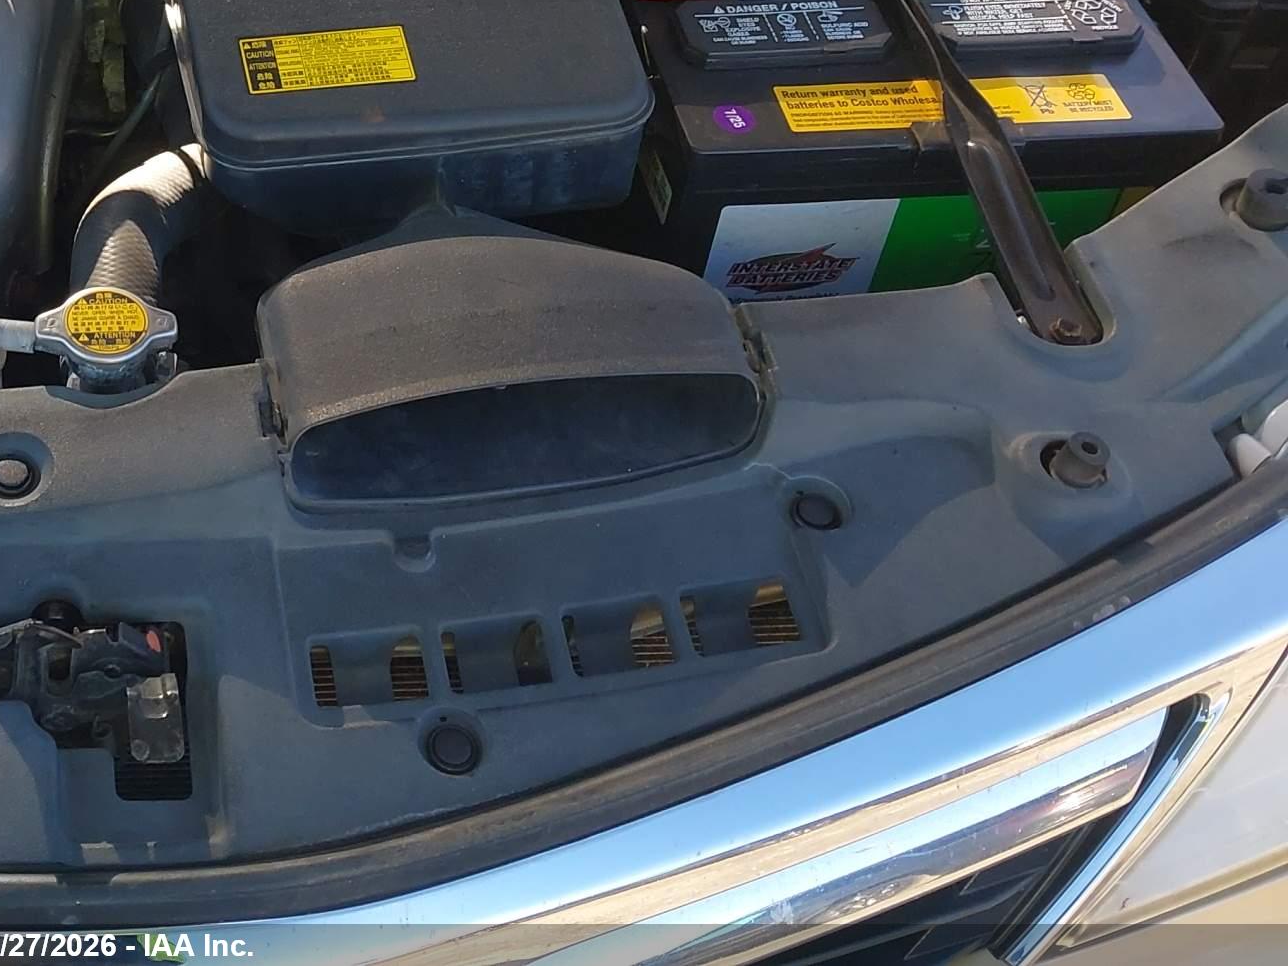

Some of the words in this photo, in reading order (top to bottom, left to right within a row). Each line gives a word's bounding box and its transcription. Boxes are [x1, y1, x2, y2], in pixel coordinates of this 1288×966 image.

[726, 3, 776, 14] DANGER
[781, 3, 787, 11] /
[790, 0, 838, 10] POISON
[246, 49, 274, 59] CAUTION
[782, 90, 818, 100] Return
[820, 88, 866, 100] warranty
[870, 86, 888, 96] and
[891, 86, 918, 94] used
[786, 100, 835, 110] batteries
[837, 100, 849, 108] to
[852, 98, 888, 106] Costco
[728, 257, 857, 276] INTERSTATE
[727, 270, 840, 287] BATTERIES
